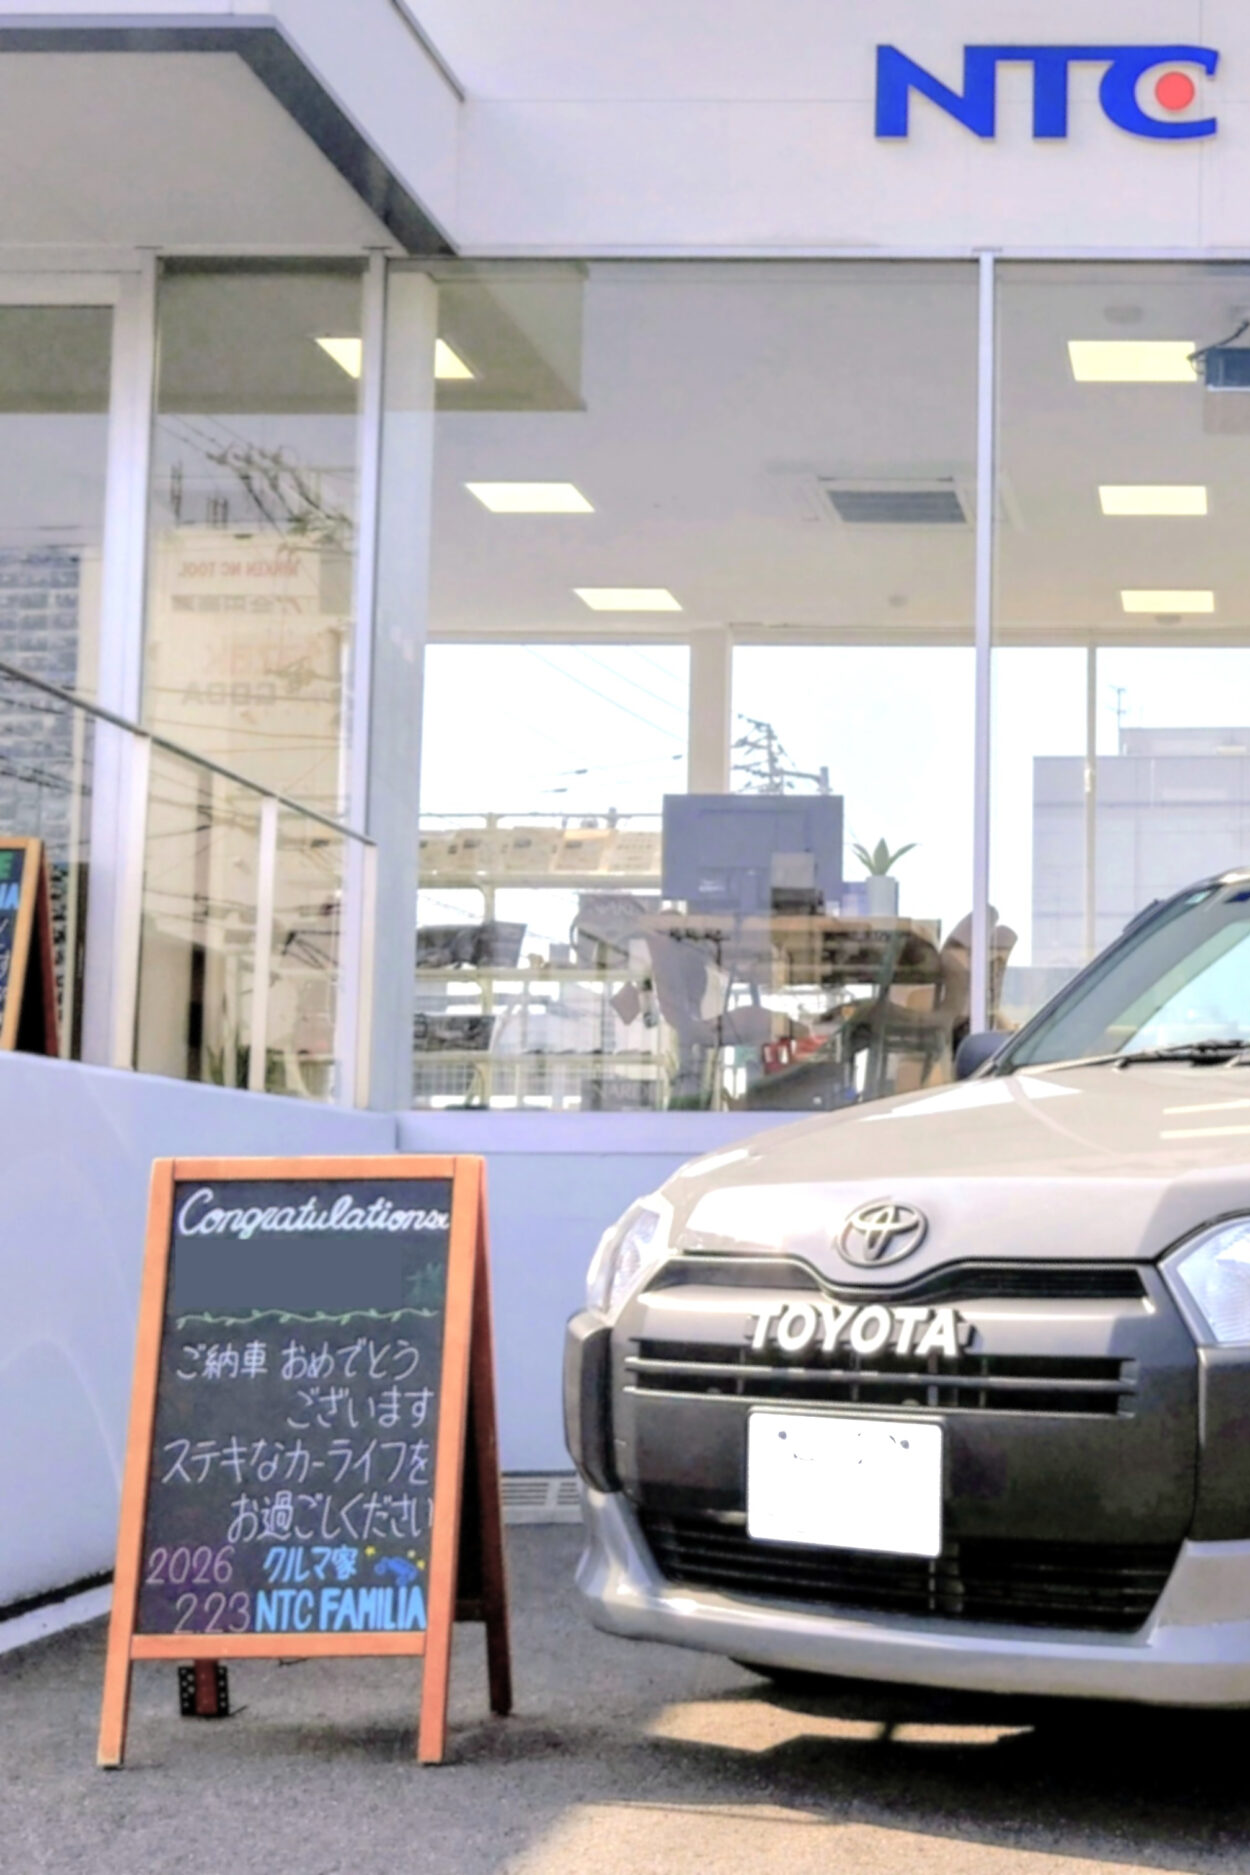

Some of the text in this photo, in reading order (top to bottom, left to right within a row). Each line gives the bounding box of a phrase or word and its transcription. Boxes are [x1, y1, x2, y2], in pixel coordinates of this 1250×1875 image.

[875, 44, 1219, 139] NTC
[749, 1303, 960, 1357] TOYOTA
[176, 1338, 420, 1381] ご納車 おめでとう
[287, 1384, 435, 1429] ございます
[161, 1435, 431, 1485] ステキなカーライフを
[226, 1490, 435, 1544] お過ごしください
[145, 1545, 236, 1584] 2026
[255, 1585, 428, 1632] NTC FAMILIA
